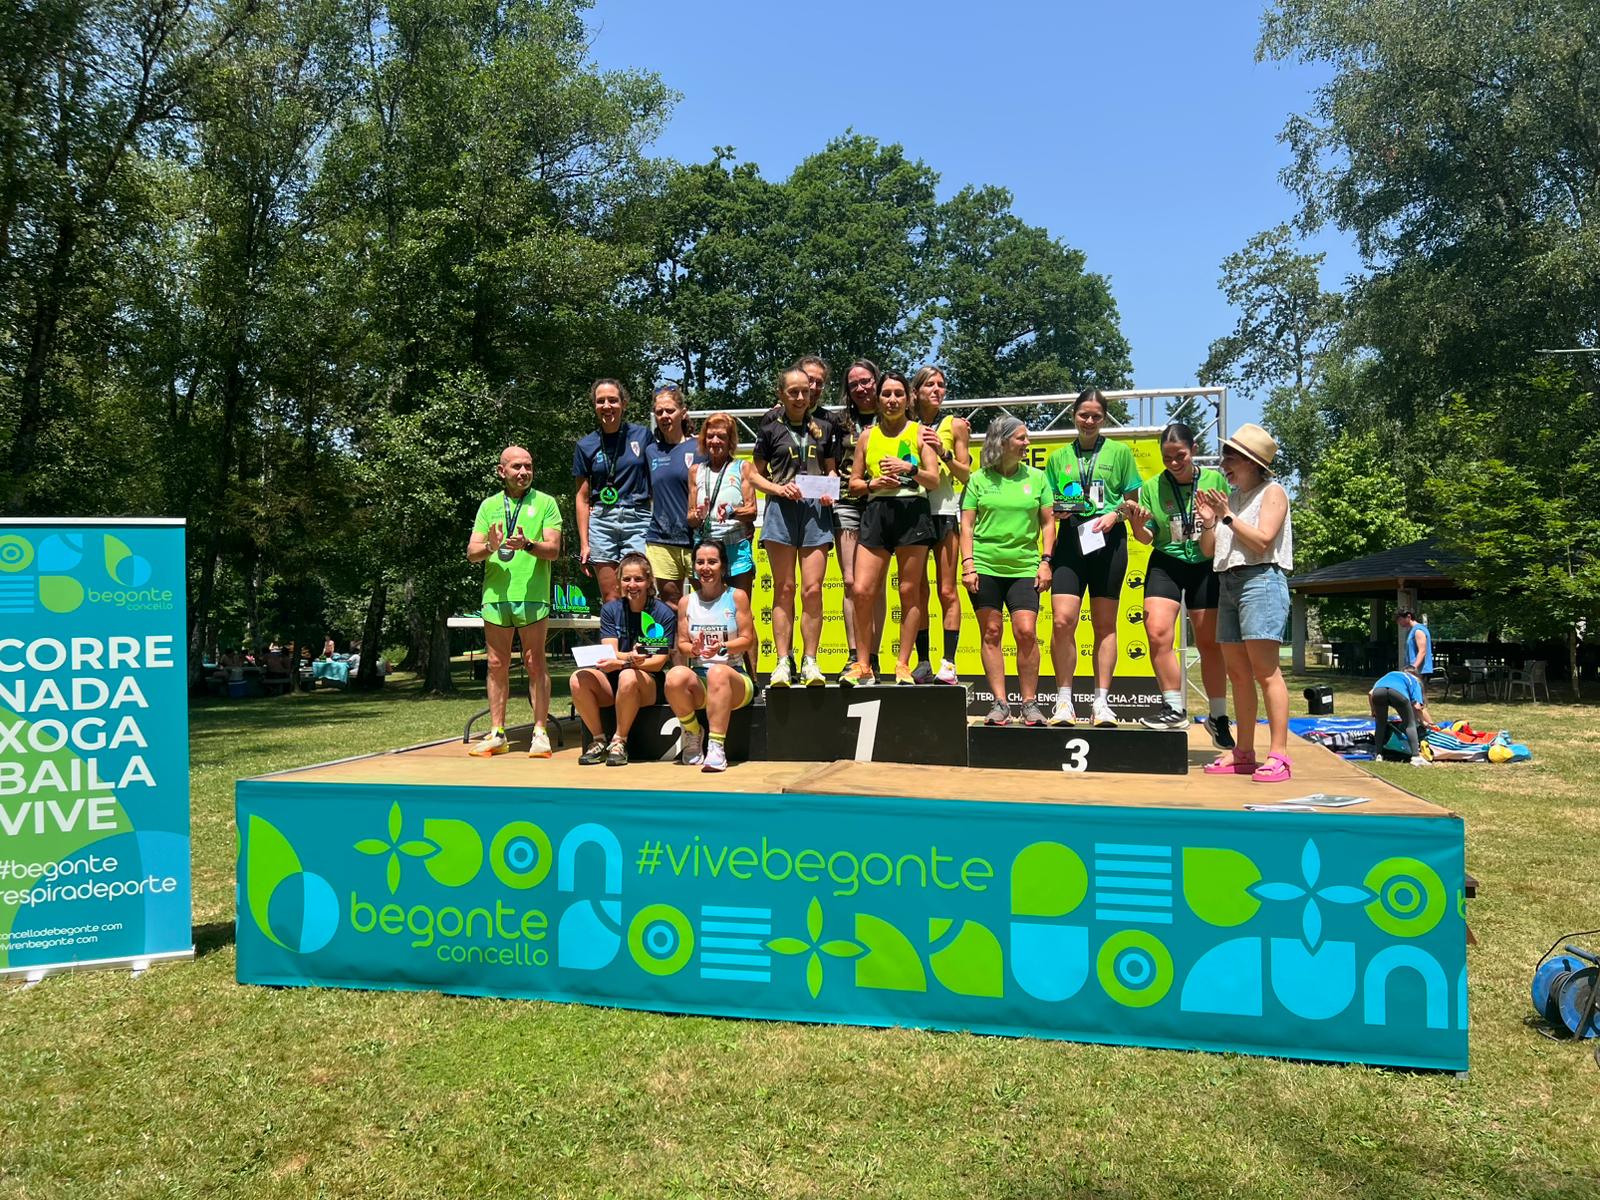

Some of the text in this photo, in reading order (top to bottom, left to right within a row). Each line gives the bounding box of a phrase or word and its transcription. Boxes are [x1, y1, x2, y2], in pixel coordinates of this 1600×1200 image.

[88, 588, 173, 607] begonte
[127, 602, 173, 611] concello
[0, 635, 174, 673] CORRE
[0, 675, 149, 713] NADA
[1073, 693, 1096, 703] TERR
[0, 715, 148, 754] XOGA
[660, 717, 685, 760] 2
[847, 699, 881, 763] 1
[1061, 738, 1090, 772] 3
[0, 755, 157, 796] BAILA
[0, 796, 118, 836] VIVE
[0, 855, 118, 882] #begonte
[635, 835, 993, 897] #vivebegonte
[350, 891, 548, 948] begonte
[437, 943, 548, 966] concello
